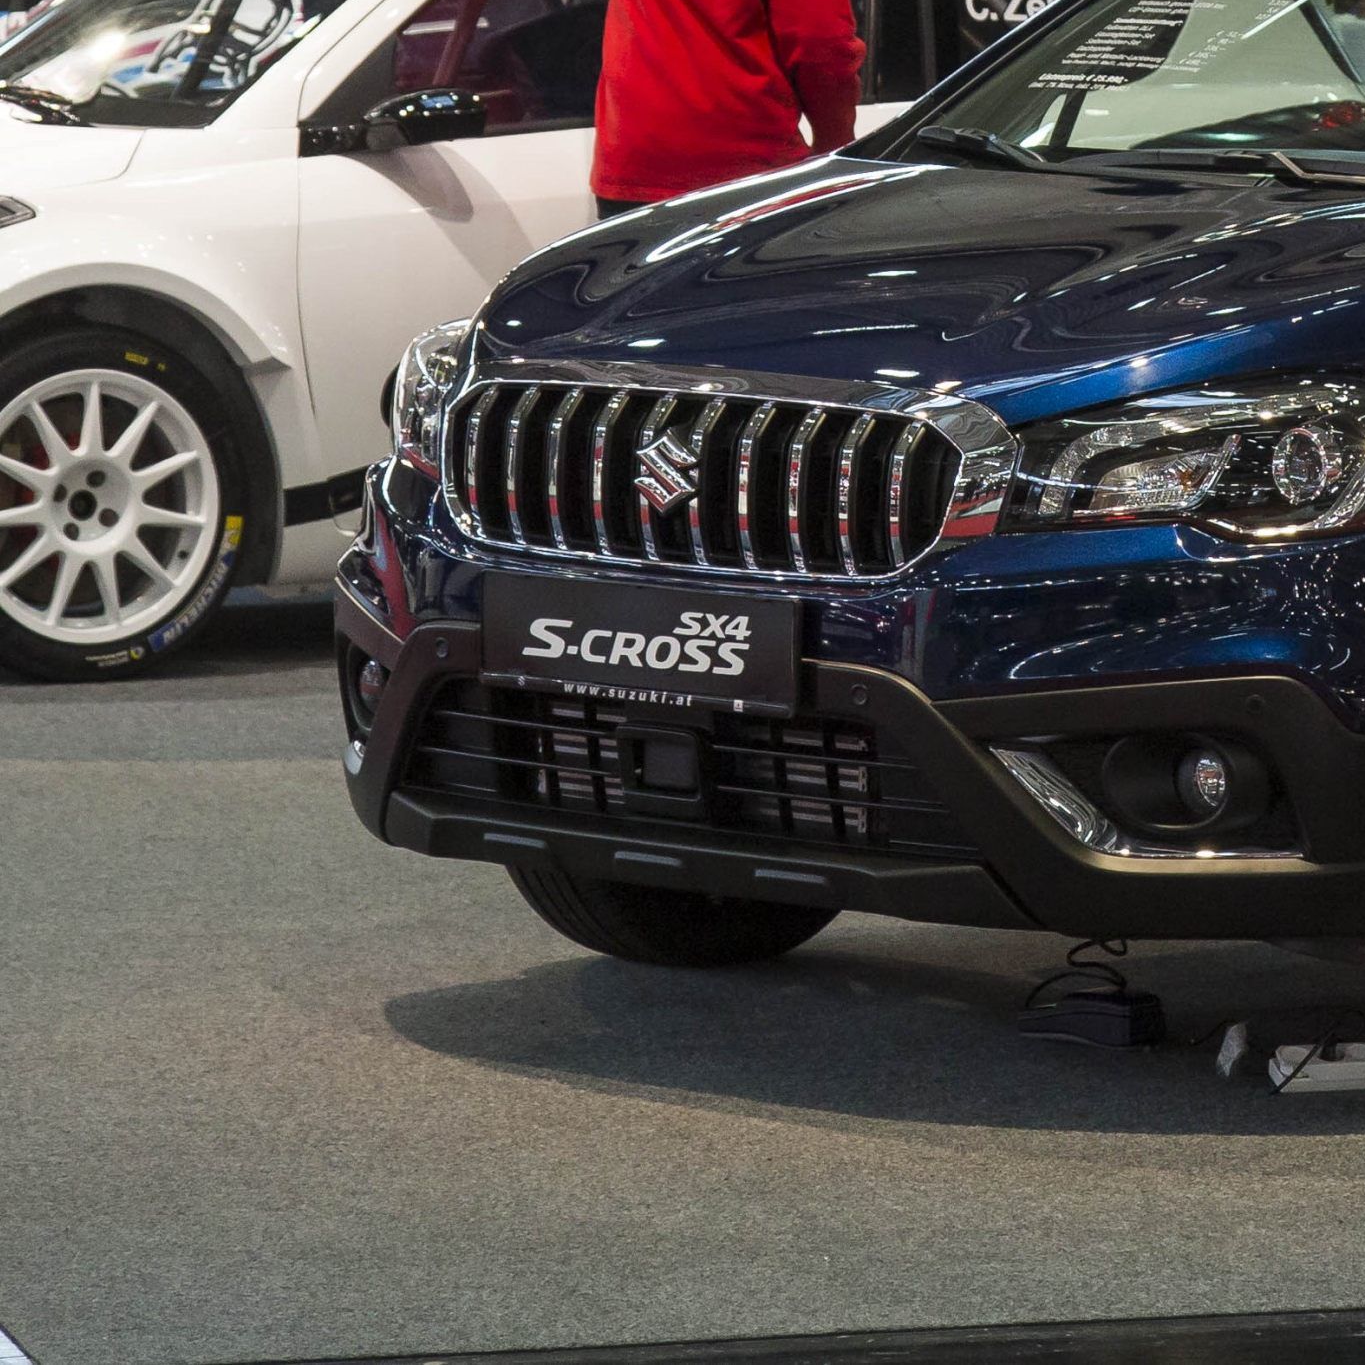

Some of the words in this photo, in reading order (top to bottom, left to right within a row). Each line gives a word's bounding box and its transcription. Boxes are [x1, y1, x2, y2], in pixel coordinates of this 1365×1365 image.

[672, 611, 752, 640] SX4
[521, 618, 750, 676] S-CROSS
[563, 683, 693, 707] www.suzuki.at
